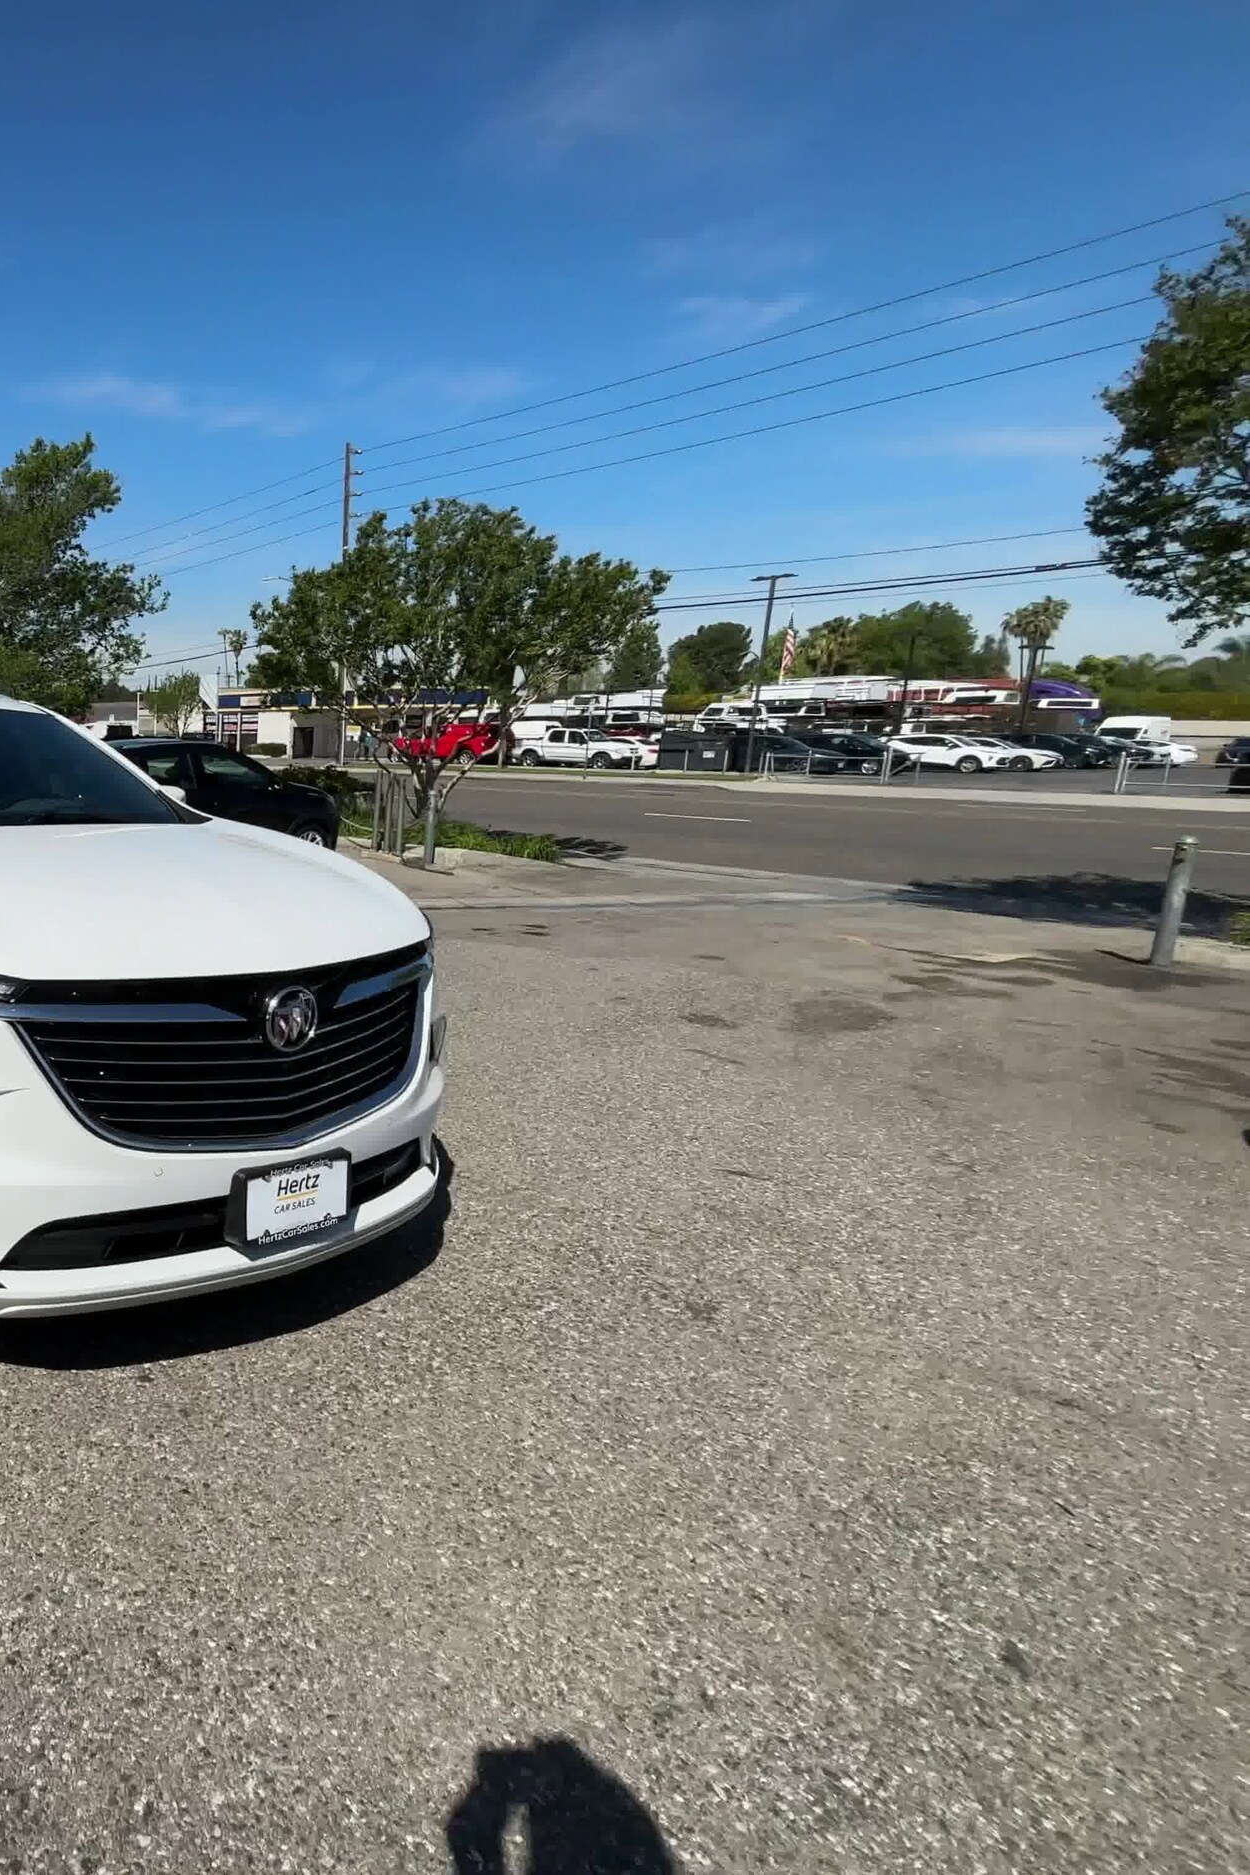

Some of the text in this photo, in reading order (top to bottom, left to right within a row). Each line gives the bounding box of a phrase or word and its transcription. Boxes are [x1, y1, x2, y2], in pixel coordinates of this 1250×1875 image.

[294, 1163, 308, 1172] Car
[277, 1174, 320, 1196] Hertz
[274, 1197, 315, 1214] CAR SALES
[258, 1218, 338, 1245] HertzCarSales.com
